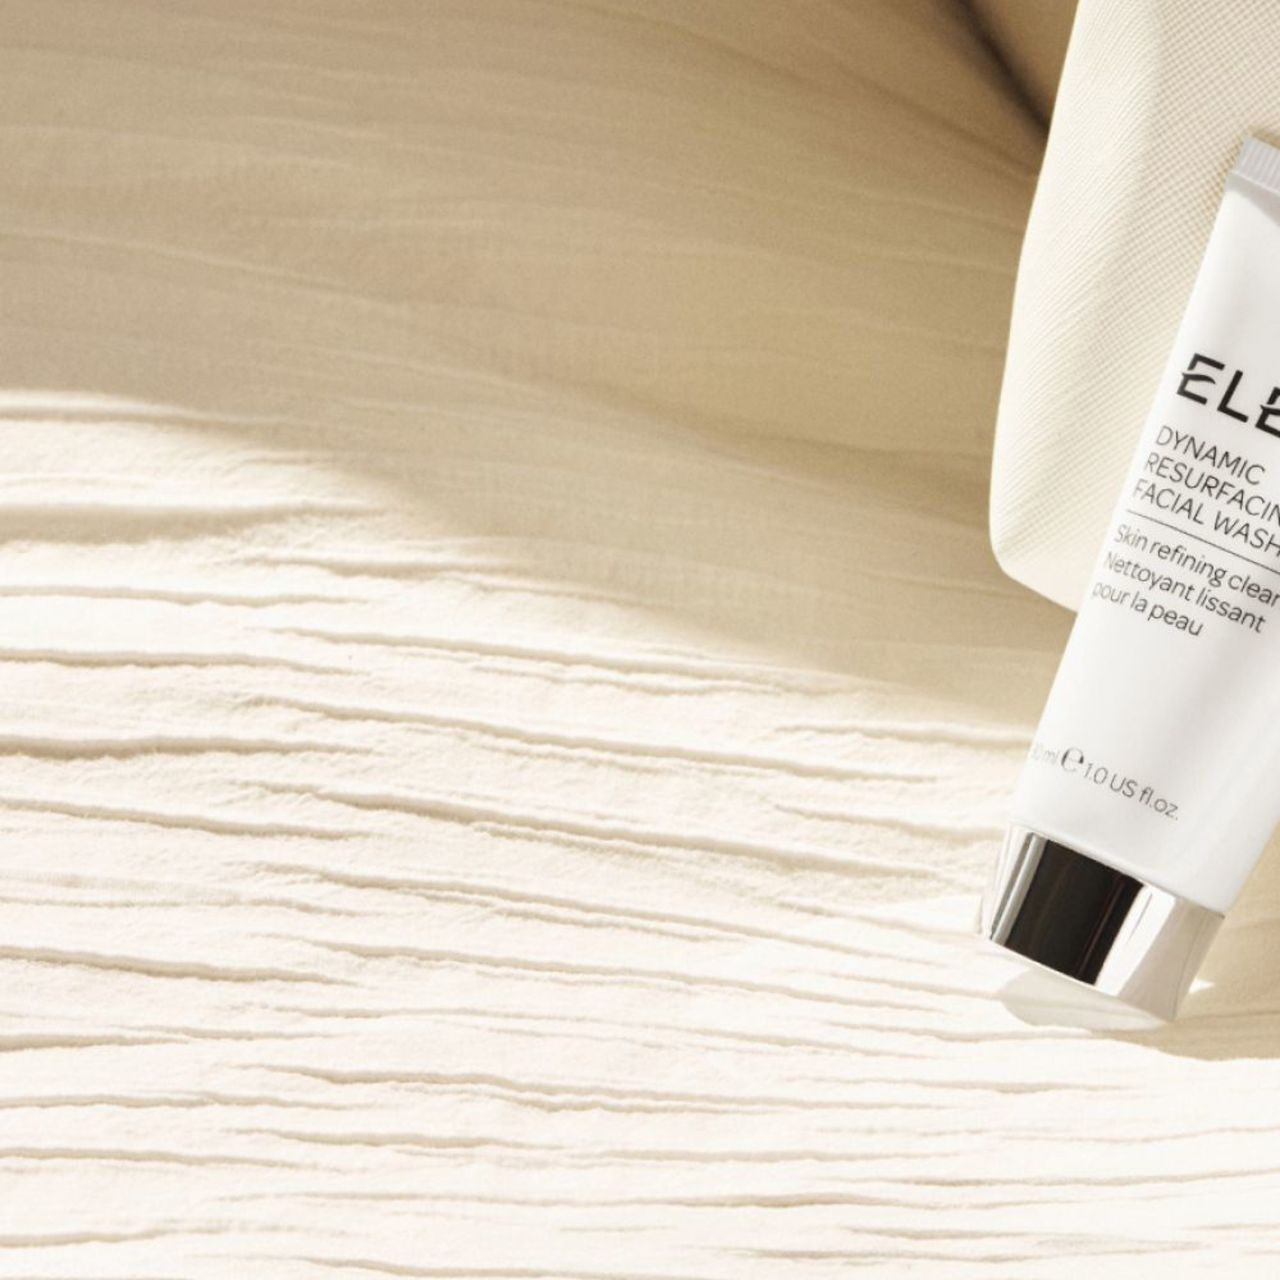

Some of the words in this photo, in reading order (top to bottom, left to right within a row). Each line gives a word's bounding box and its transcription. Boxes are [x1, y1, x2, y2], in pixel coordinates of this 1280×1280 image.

[1156, 425, 1266, 486] DYNAMIC
[1132, 479, 1204, 525] FACIAL
[1115, 524, 1148, 551] Skin
[1149, 539, 1226, 587] refining
[1092, 581, 1131, 607] pour
[1130, 592, 1148, 613] la
[1148, 603, 1203, 637] peau
[1104, 550, 1195, 601] Nettoyant
[1196, 589, 1266, 633] lissant
[1110, 773, 1138, 798] US
